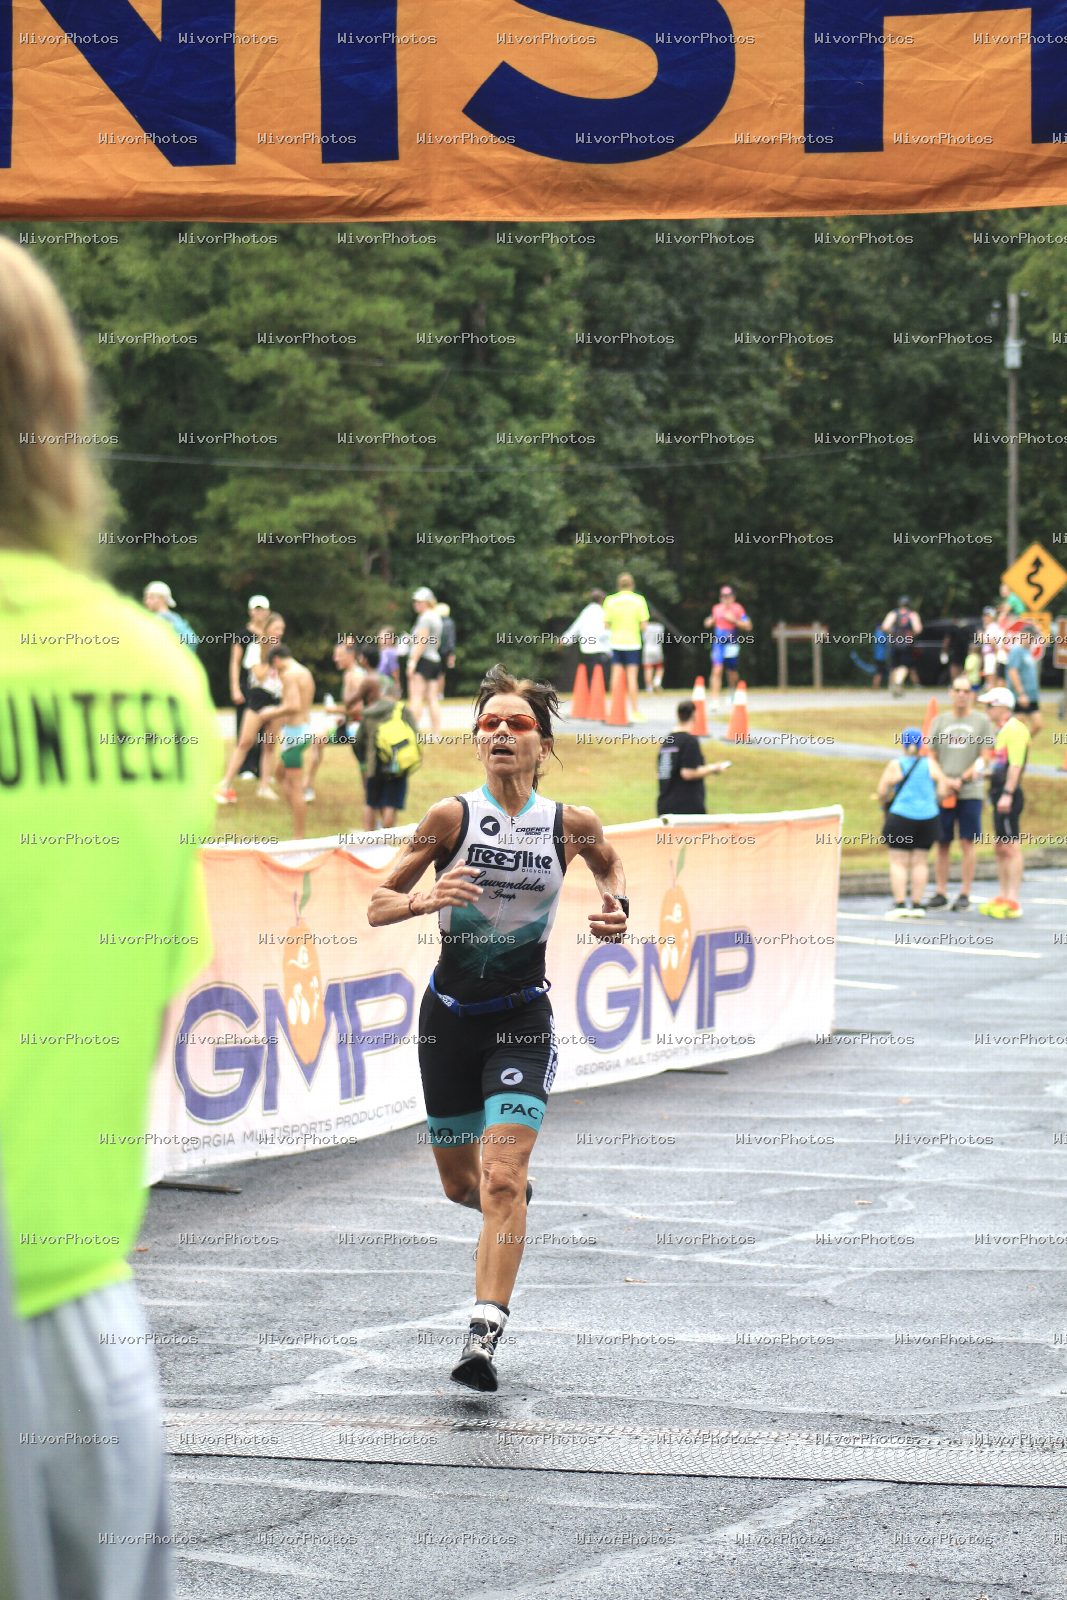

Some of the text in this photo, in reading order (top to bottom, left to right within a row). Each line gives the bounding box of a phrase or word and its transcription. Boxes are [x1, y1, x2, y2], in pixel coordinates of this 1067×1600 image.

[0, 690, 184, 786] UNTEE
[465, 843, 553, 872] free-flite
[489, 889, 516, 902] Group
[576, 926, 756, 1054] GMP
[174, 968, 416, 1126] GMP
[336, 1096, 418, 1128] PRODUCTIONS
